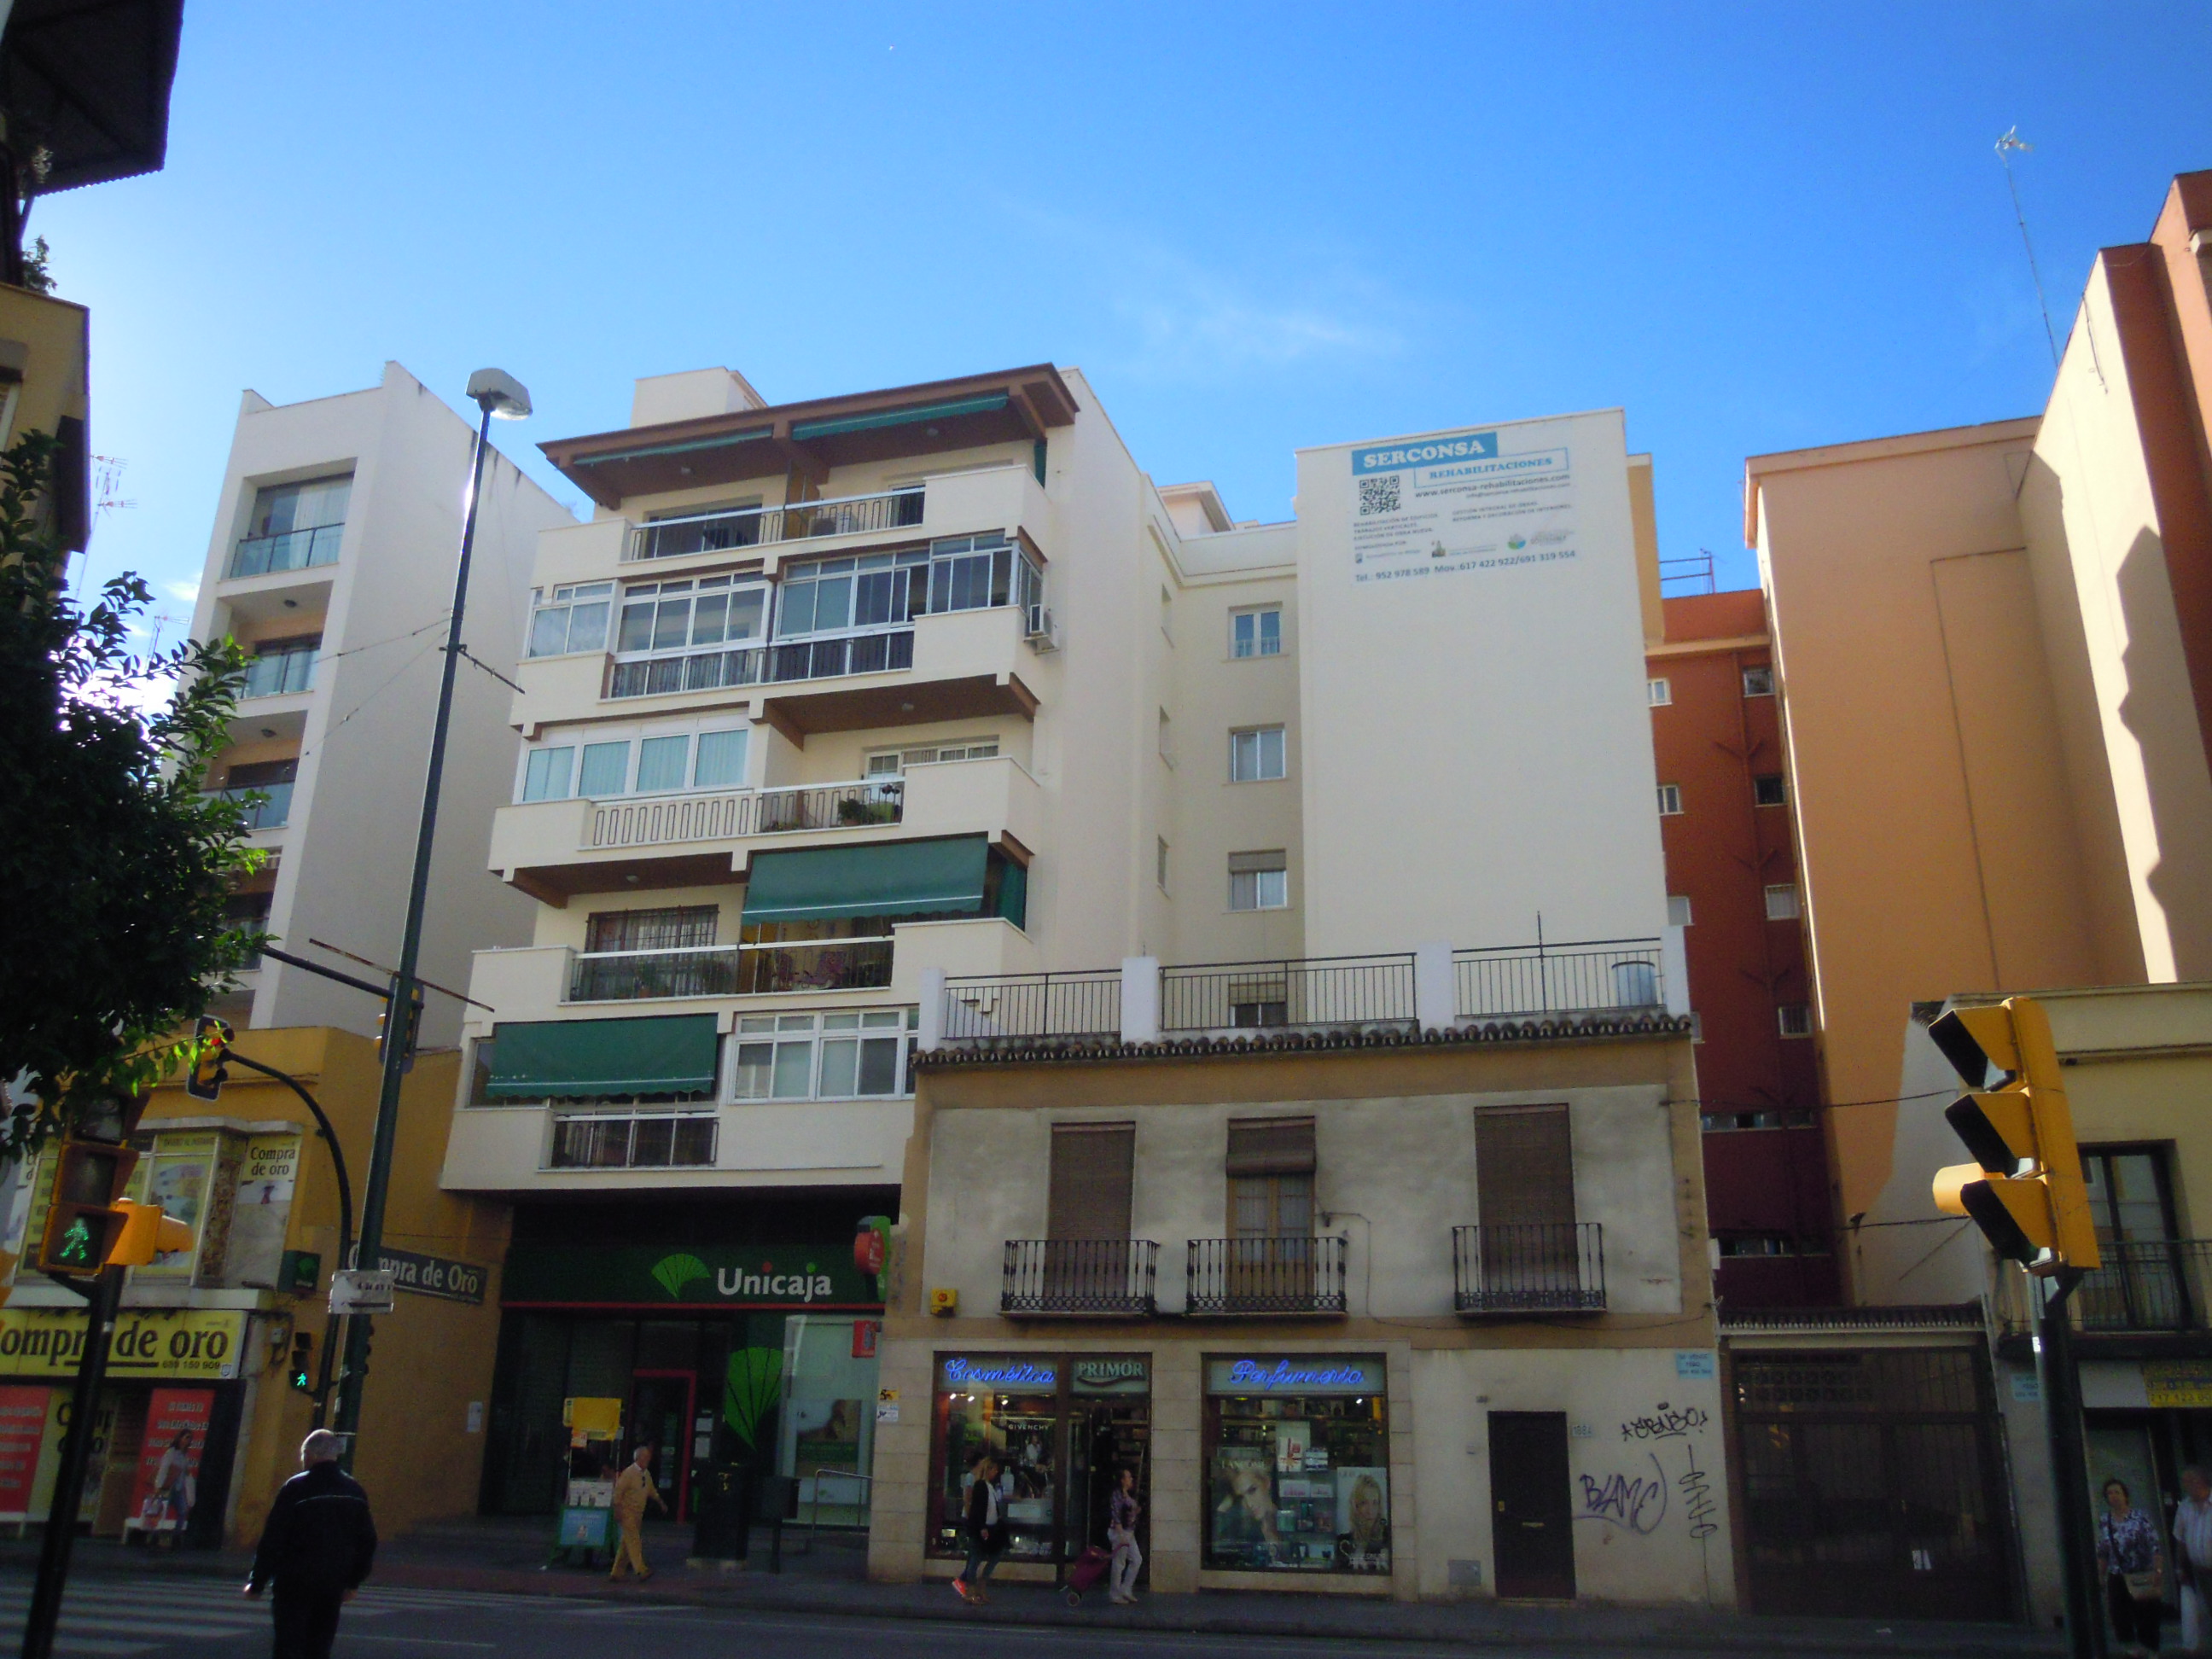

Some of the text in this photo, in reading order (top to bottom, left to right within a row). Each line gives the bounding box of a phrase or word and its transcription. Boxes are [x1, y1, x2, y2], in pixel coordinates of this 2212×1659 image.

[1364, 440, 1486, 469] SERCONSA
[1429, 457, 1552, 480] REHABILITACIONES
[1415, 474, 1570, 498] www.serconsa-rehabilitaciones.com
[1376, 571, 1392, 580] 952
[1394, 569, 1410, 578] 978
[1412, 568, 1429, 576] 589
[1478, 559, 1495, 568] 422
[1498, 555, 1536, 567] 922/691
[1540, 553, 1556, 562] 319
[1558, 550, 1575, 559] 554
[250, 1146, 296, 1164] Compra
[251, 1163, 289, 1176] de oro
[422, 1259, 443, 1289] de
[448, 1264, 479, 1294] Oro
[718, 1260, 833, 1303] Unicaja
[115, 1321, 158, 1359] de
[170, 1330, 228, 1359] oro
[945, 1358, 1056, 1384] Cosmética
[1230, 1359, 1365, 1391] Perfumería
